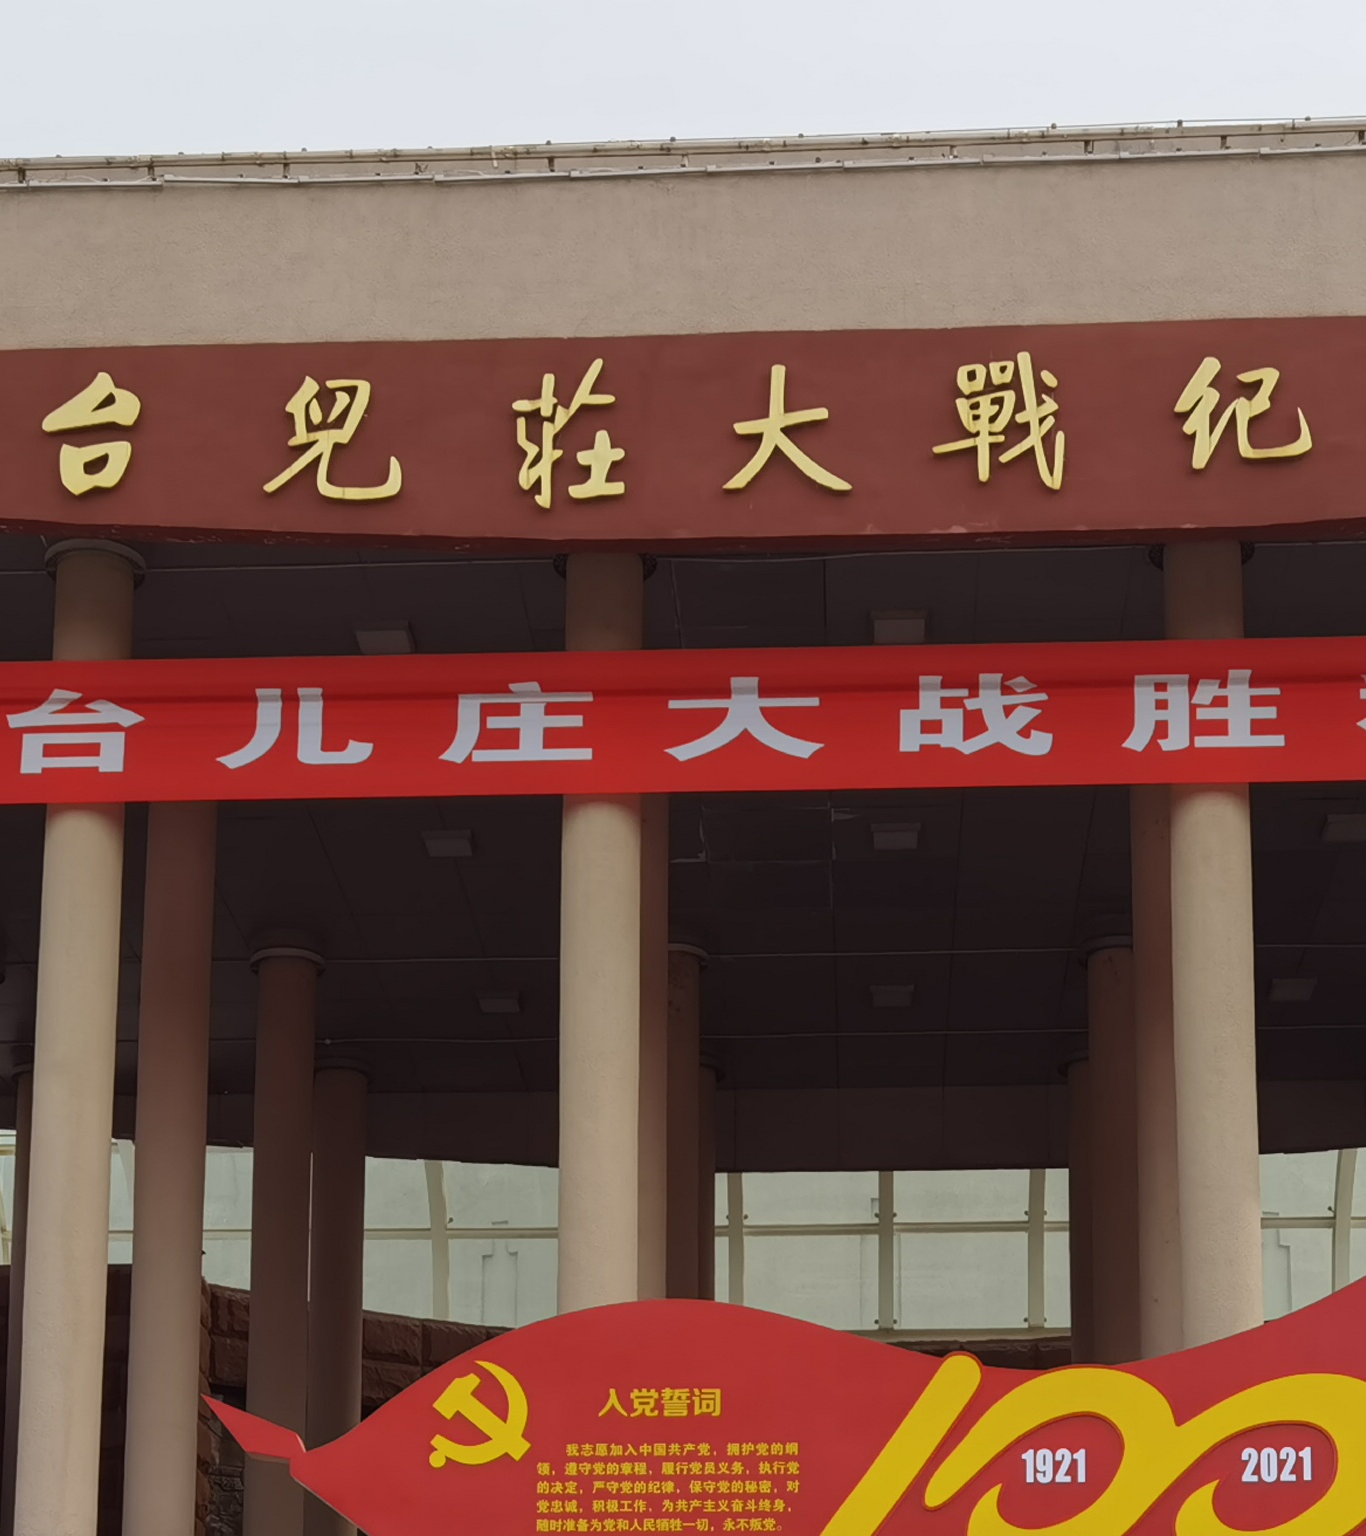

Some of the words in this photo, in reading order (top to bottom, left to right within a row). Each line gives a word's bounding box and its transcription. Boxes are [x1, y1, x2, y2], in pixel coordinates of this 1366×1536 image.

[598, 1388, 721, 1417] 入党誓词
[1021, 1448, 1086, 1484] 1921
[1241, 1446, 1312, 1483] 2021
